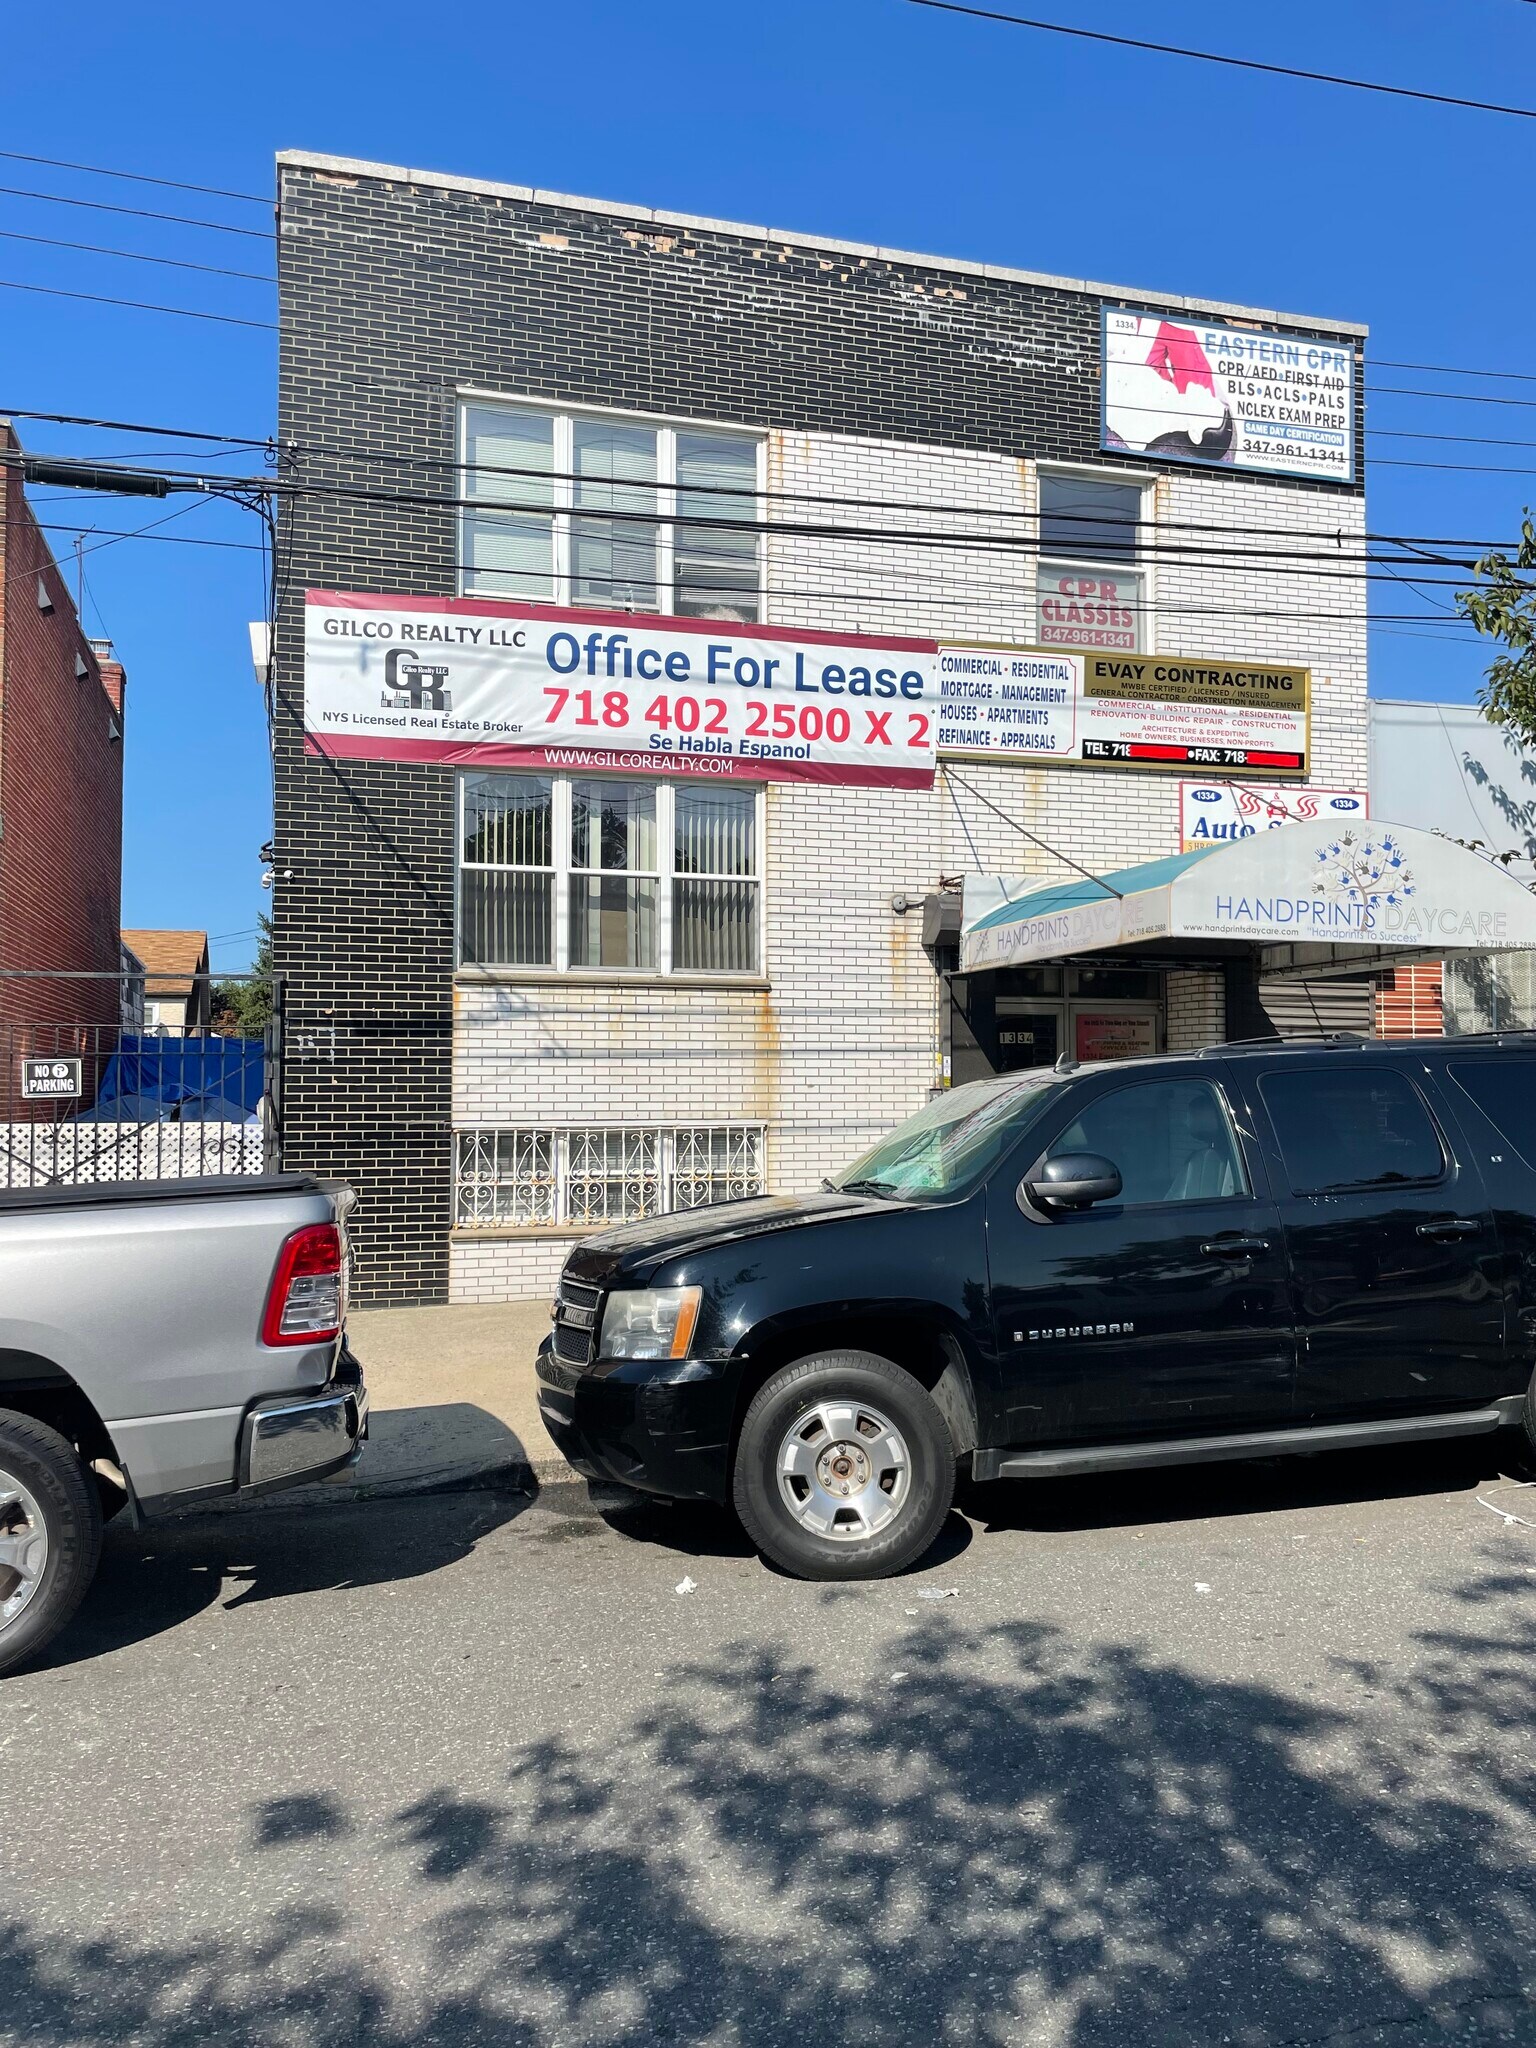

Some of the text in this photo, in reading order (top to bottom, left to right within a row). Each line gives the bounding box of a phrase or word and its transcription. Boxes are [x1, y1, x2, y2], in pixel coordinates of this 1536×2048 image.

[1205, 332, 1346, 374] EASTERN CPR
[1323, 376, 1345, 391] AID
[1237, 401, 1346, 430] NCLEX EXAM PREP
[1245, 423, 1343, 446] SAME DAY CERTIFICATION
[1242, 439, 1346, 464] 347-961-1341
[1058, 576, 1118, 602] CPR
[1041, 598, 1134, 628] CLASSES
[323, 618, 526, 648] GILCO REALTY LLC
[1043, 627, 1131, 647] 347-961-1341
[435, 667, 448, 675] LLC
[545, 631, 925, 700] Office For Lease
[941, 656, 1069, 681] COMMERCIAL RESIDENTIAL
[1095, 661, 1294, 691] EVAY CONTRACTING
[940, 680, 1067, 704] MORTGAGE MANAGEMENT
[1090, 688, 1126, 698] GENERAL
[1128, 690, 1180, 702] CONTRACTOR
[1187, 695, 1247, 706] CONSTRUCTION
[1248, 700, 1302, 710] MANAGEMENT
[1120, 682, 1146, 691] MWBE
[1148, 684, 1187, 694] CERTIFIED
[1194, 687, 1230, 697] LICENSED
[1237, 691, 1270, 700] INSURED
[542, 686, 931, 748] 718 402 2500 X 2
[940, 704, 1049, 726] HOUSES APARTMENTS
[1098, 700, 1156, 711] COMMERCIAL
[1164, 704, 1229, 716] INSTITUTIONAL
[1239, 710, 1292, 720] RESIDENTIAL
[322, 711, 524, 733] NYS Licensed Real Estate Broker
[1141, 725, 1197, 735] ARCHITECTURE
[1206, 729, 1249, 738] EXPEDITING
[1193, 717, 1224, 726] REPAIR
[1232, 719, 1297, 730] CONSTRUCTION
[648, 733, 811, 760] Se Habla Espanol
[938, 728, 1056, 750] REFINANCE APPRAISALS
[1119, 731, 1143, 740] HOME
[1226, 738, 1274, 748] NON-PROFITS
[544, 748, 734, 774] WWW.GILCOREALTY.COM
[1085, 741, 1109, 756] TEL:
[1195, 749, 1221, 762] FAX:
[1196, 791, 1215, 801] 1334
[1334, 799, 1354, 809] 1334
[1191, 816, 1256, 839] Auto
[1215, 895, 1507, 938] HANDPRINTS DAYCARE
[997, 915, 1069, 951] HANDPRINTS
[1183, 923, 1299, 936] www.handprintsdaycare.com
[34, 1064, 50, 1078] NO
[29, 1078, 75, 1092] PARKING
[1028, 1322, 1134, 1340] SUBURBAN
